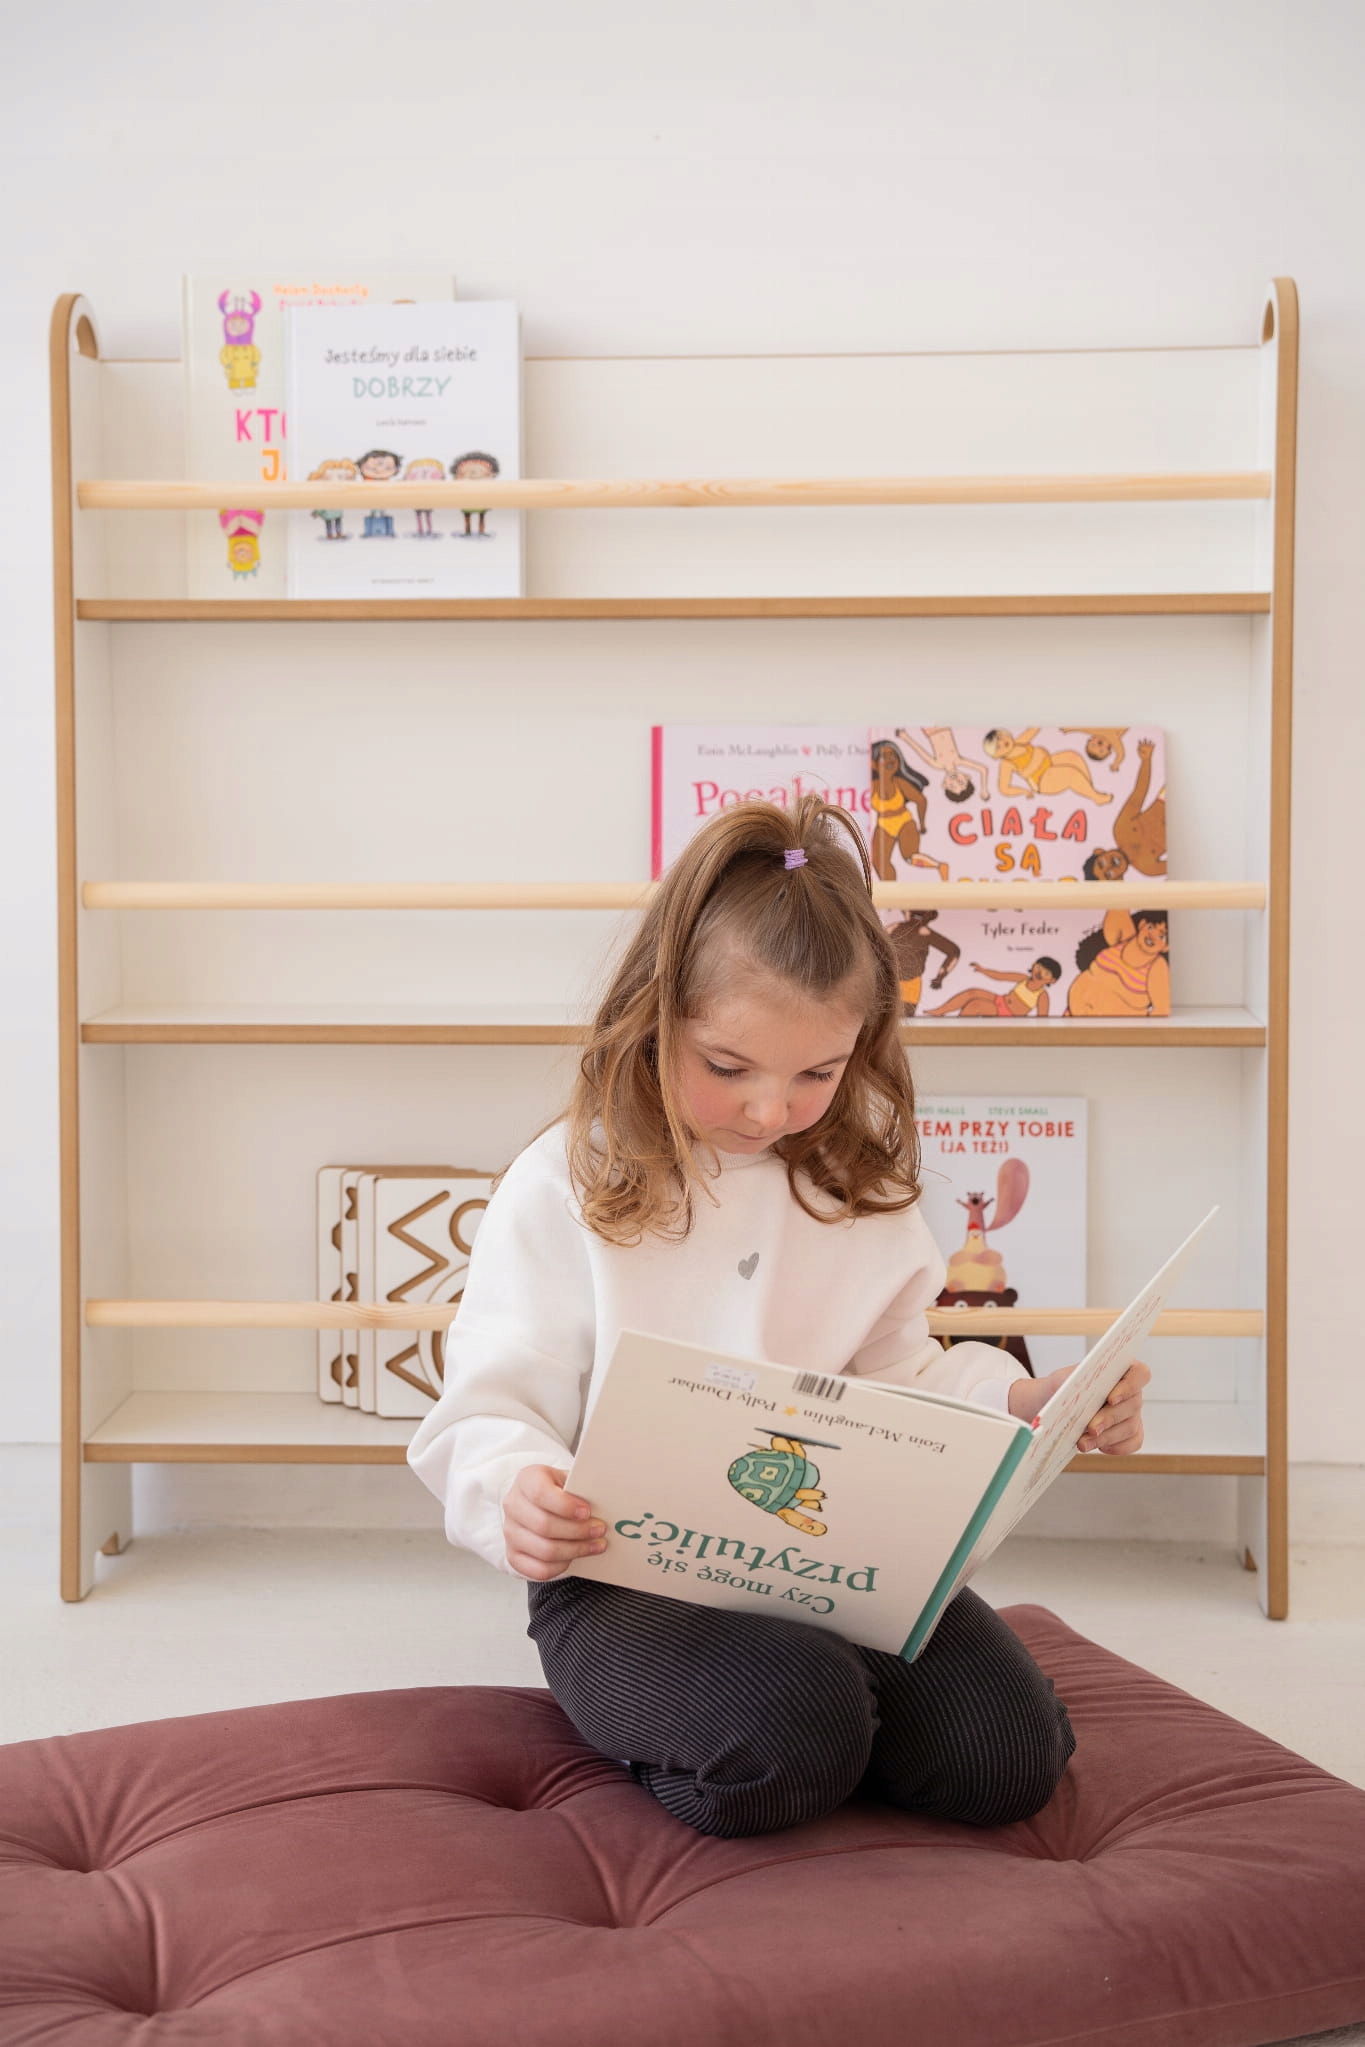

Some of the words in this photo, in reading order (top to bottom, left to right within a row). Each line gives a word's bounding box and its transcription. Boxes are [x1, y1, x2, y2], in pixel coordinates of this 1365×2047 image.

[324, 346, 400, 368] Jesteśmy
[403, 345, 430, 362] dla
[433, 345, 478, 362] siebie
[352, 376, 452, 399] DOBRZY
[261, 449, 288, 481] J
[948, 806, 1088, 846] CIAŁA
[994, 842, 1042, 877] SĄ
[981, 922, 1015, 939] Tyler
[1020, 920, 1059, 936] Feder
[960, 1120, 1010, 1137] PRZY
[1017, 1120, 1075, 1137] TOBIE
[940, 1140, 967, 1154] (JA
[668, 1376, 732, 1400] Dunbar
[737, 1392, 777, 1413] Polly
[803, 1409, 901, 1443] McLaughlin
[909, 1434, 948, 1454] Eoin
[614, 1511, 880, 1593] przytulić?
[647, 1551, 689, 1574] się
[696, 1565, 774, 1596] mogę
[780, 1586, 835, 1615] Czy
